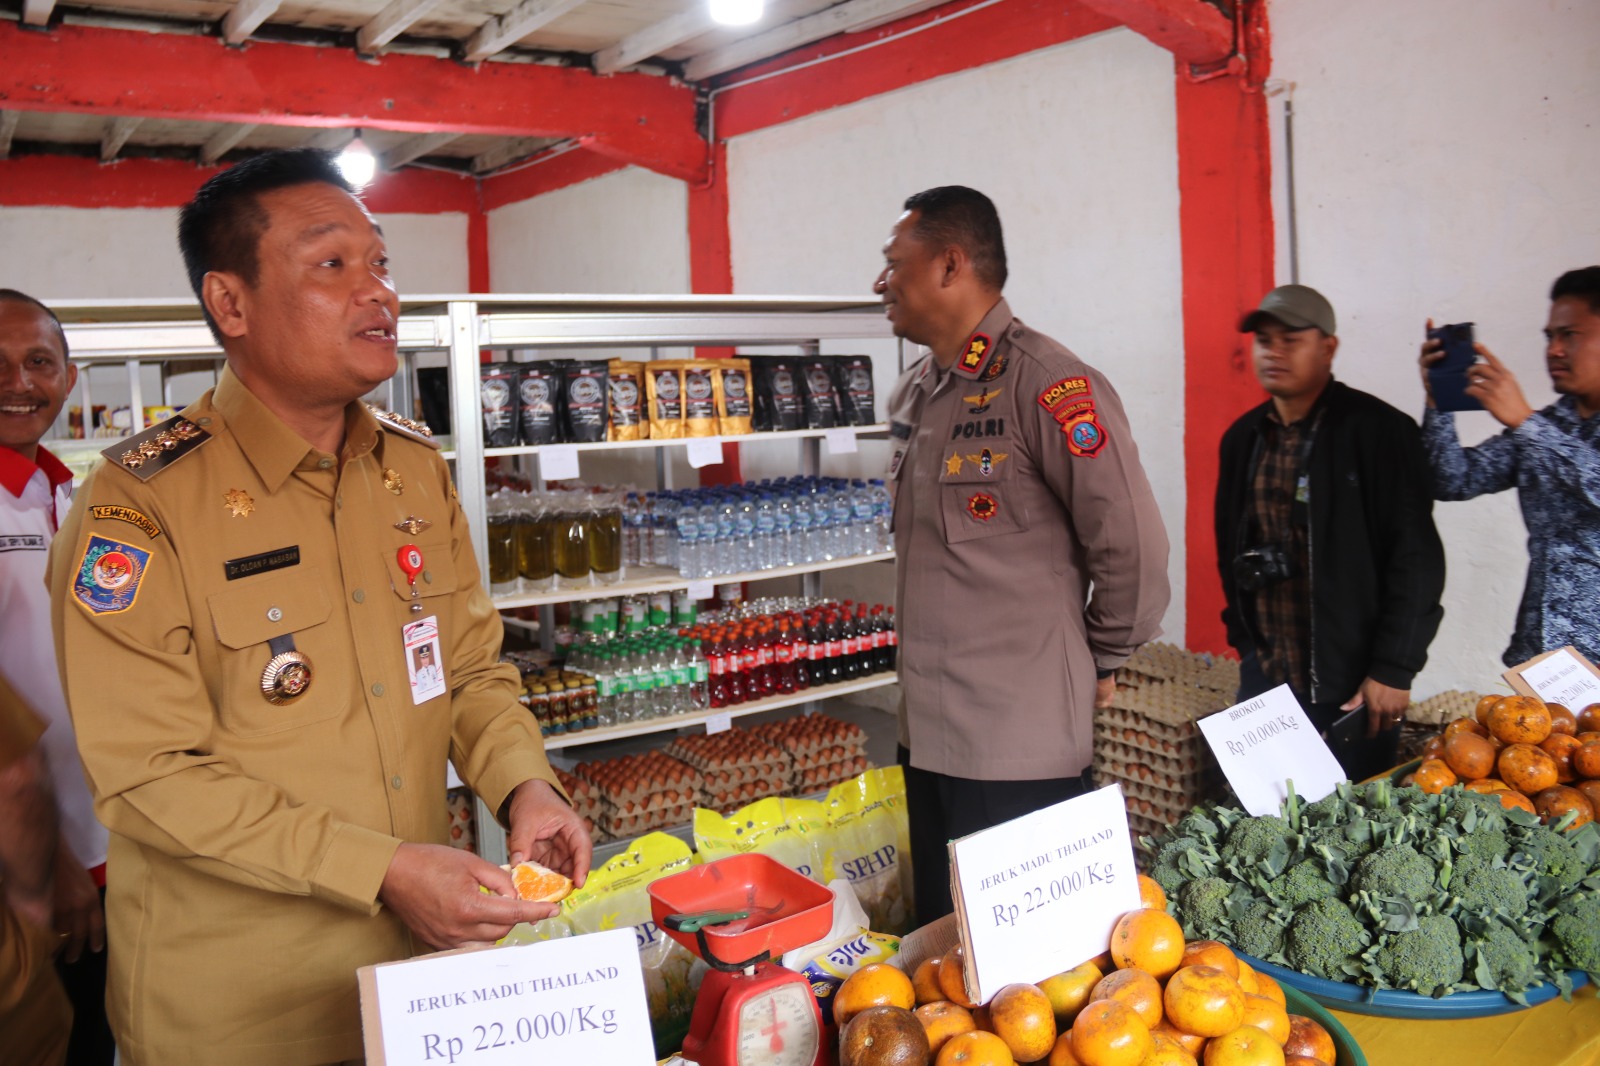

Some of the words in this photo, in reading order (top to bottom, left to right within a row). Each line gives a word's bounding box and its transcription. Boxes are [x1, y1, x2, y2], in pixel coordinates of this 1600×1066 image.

[1044, 379, 1087, 404] POLRES
[951, 418, 1004, 440] POLRI
[1228, 699, 1266, 721] BROKOLI
[1225, 740, 1245, 756] Rp
[1243, 715, 1300, 748] 10.000/Kg
[842, 844, 895, 880] SPHP
[980, 867, 1019, 891] JERUK
[1020, 851, 1053, 875] MADU
[1055, 828, 1113, 859] THAILAND
[992, 903, 1019, 927] Rp
[1023, 862, 1115, 913] 22.000/Kg
[407, 991, 468, 1013] JERUK
[472, 982, 525, 1003] MADU
[529, 966, 619, 993] THAILAND
[421, 1033, 464, 1064] Rp
[472, 1004, 618, 1052] 22.000/Kg
